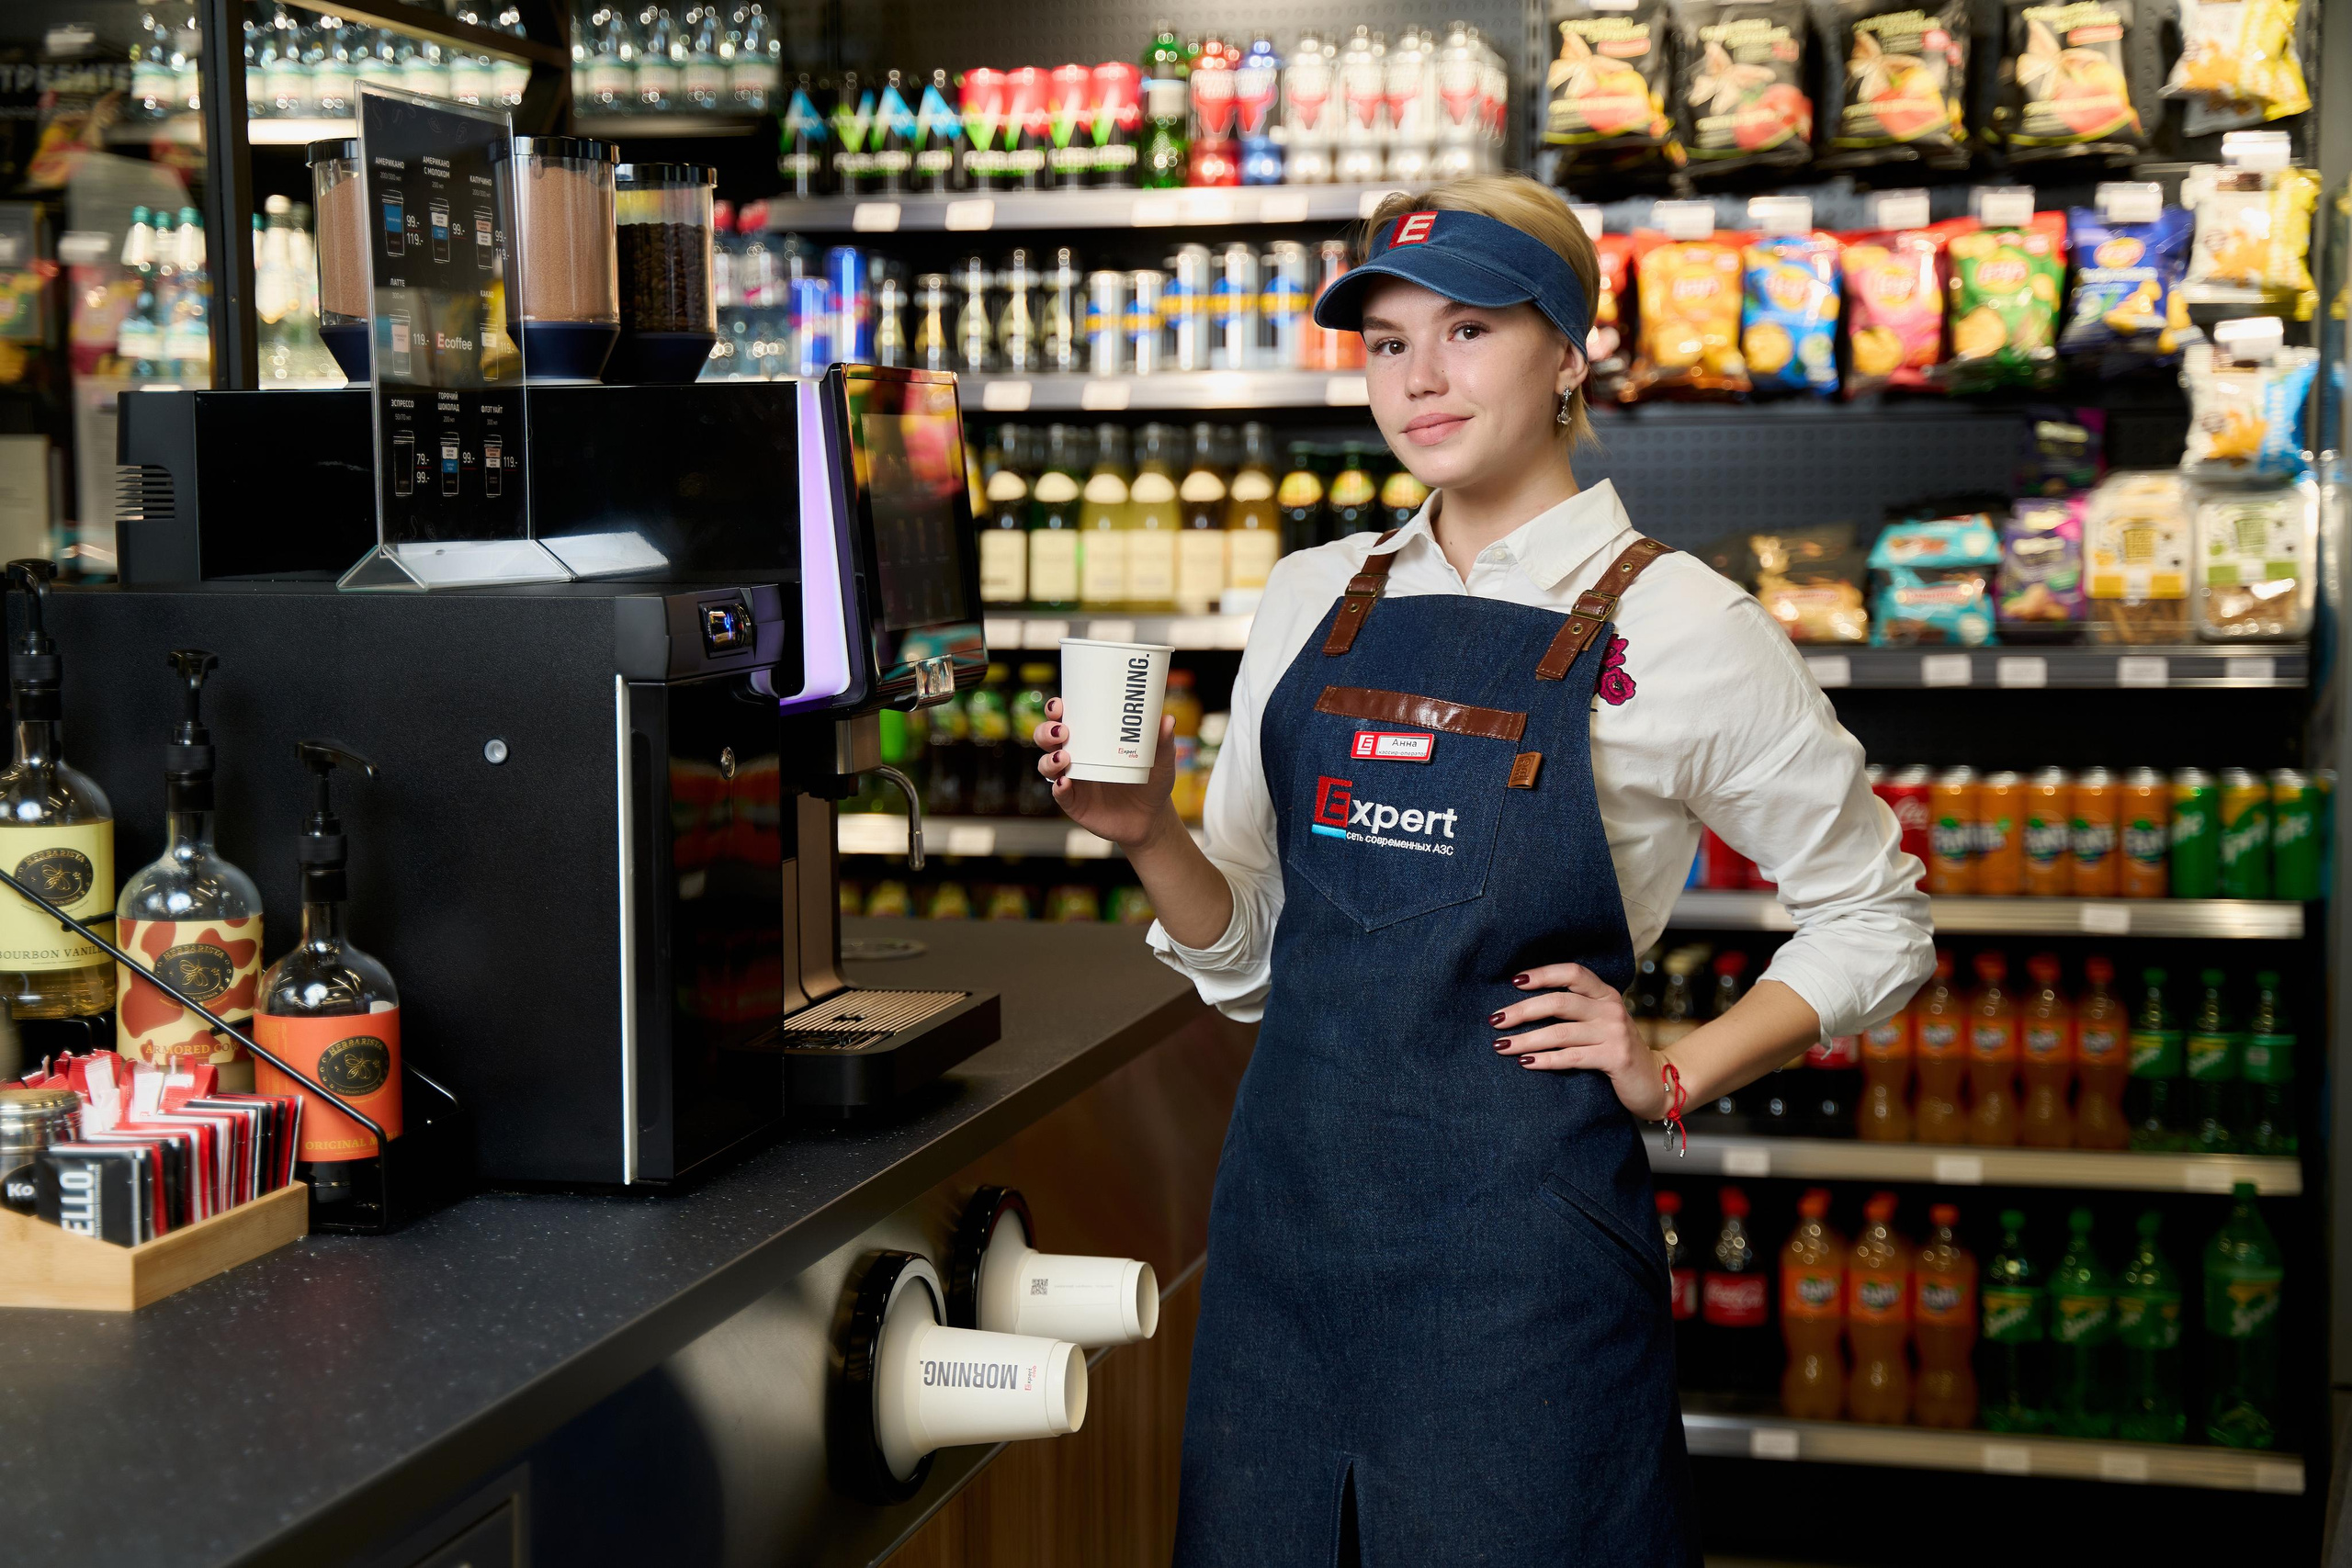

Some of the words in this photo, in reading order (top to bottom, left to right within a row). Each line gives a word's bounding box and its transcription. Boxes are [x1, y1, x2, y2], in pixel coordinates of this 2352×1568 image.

[375, 157, 405, 169] АМЕРИКАНО
[423, 156, 450, 168] АМЕРИКАНО
[427, 168, 450, 178] МОЛОКОМ
[469, 175, 492, 186] КАПУЧИНО
[406, 214, 420, 228] 99.-
[452, 223, 465, 236] 99.-
[1396, 215, 1437, 243] E
[406, 232, 424, 246] 119.-
[390, 277, 405, 288] ЛАТТЕ
[413, 333, 430, 345] 119.-
[436, 332, 473, 351] Ecoffee
[438, 391, 458, 400] ГОРЯЧИЙ
[390, 399, 414, 408] ЭСПРЕССО
[437, 402, 459, 412] ШОКОЛАД
[416, 453, 430, 466] 79.-
[462, 452, 475, 464] 99.-
[503, 456, 517, 468] 119.-
[416, 471, 430, 483] 99.-
[1119, 653, 1149, 743] MORNING.
[1392, 739, 1418, 748] Анна
[1314, 775, 1458, 839] Expert
[1346, 830, 1364, 842] сеть
[1365, 834, 1431, 853] современных
[1432, 842, 1454, 856] АЗС
[0, 949, 59, 960] BOURBON
[64, 945, 107, 957] VANILL
[163, 944, 225, 960] HERBARISTA
[145, 1044, 210, 1054] ARMORED
[214, 1041, 240, 1053] COW
[328, 1037, 383, 1056] HERBARISTA
[305, 1138, 367, 1151] ORIGINAL
[369, 1130, 399, 1145] MPLE
[60, 1164, 94, 1236] ELLO.
[920, 1359, 1019, 1390] MORNING.
